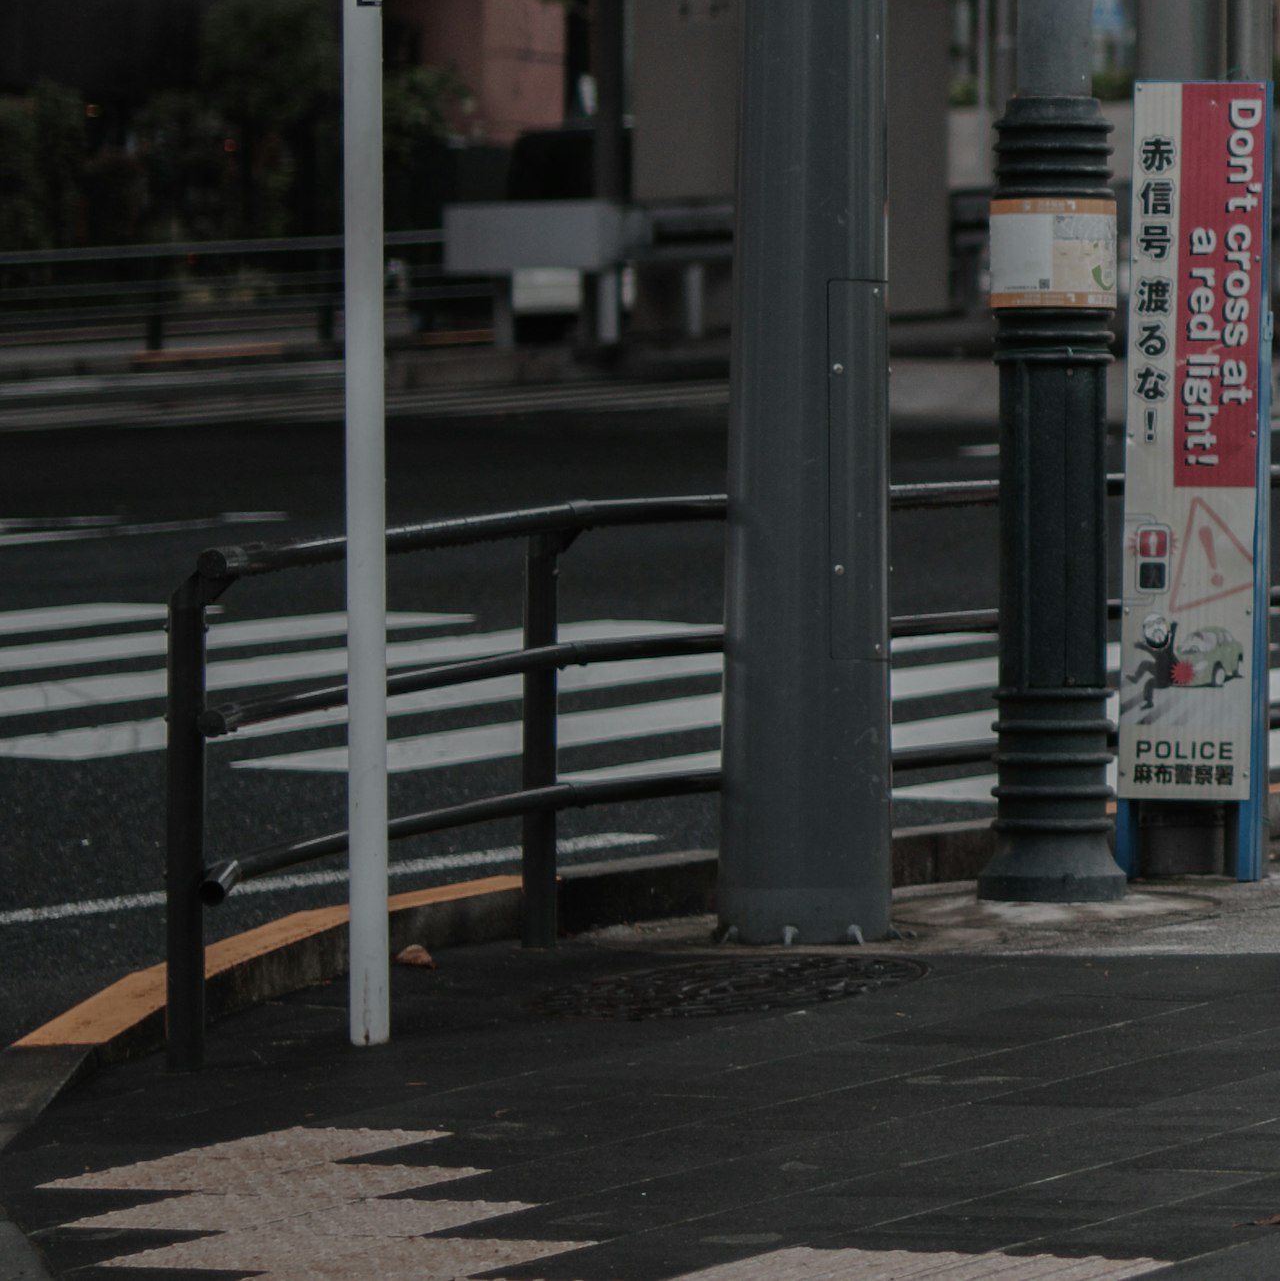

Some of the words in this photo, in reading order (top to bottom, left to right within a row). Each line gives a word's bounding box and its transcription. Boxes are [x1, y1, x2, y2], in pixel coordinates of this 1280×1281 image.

[1225, 99, 1262, 213] Don't
[1190, 227, 1216, 256] a
[1186, 268, 1220, 341] red
[1222, 224, 1251, 347] cross
[1182, 354, 1219, 466] light!
[1220, 359, 1252, 406] at
[1133, 763, 1234, 786] 麻布警察署
[1136, 740, 1234, 760] POLICE
